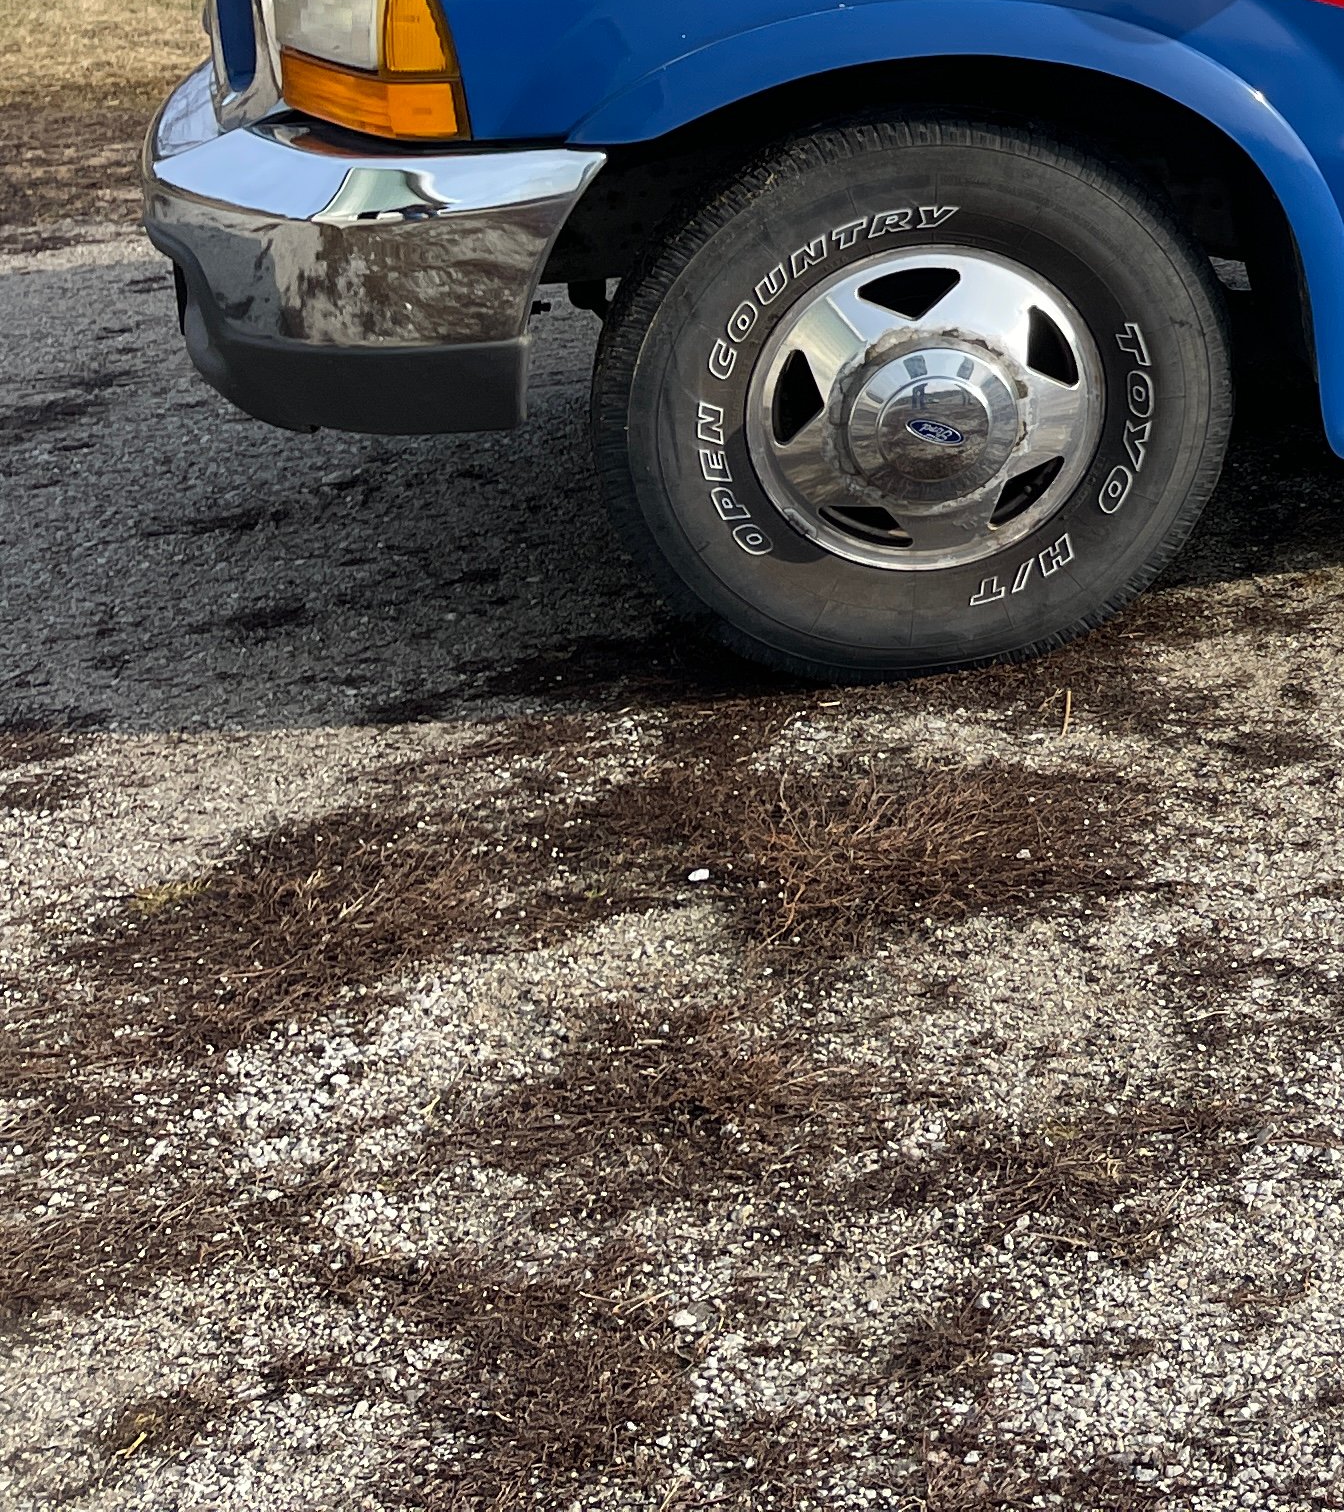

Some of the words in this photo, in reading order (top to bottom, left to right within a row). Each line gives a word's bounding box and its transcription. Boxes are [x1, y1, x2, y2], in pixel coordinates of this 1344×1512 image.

[708, 204, 962, 381] COUNTRY
[695, 402, 774, 557] OPEN
[918, 423, 953, 442] Ford
[1097, 321, 1155, 516] TOYO
[968, 532, 1076, 607] H/T
